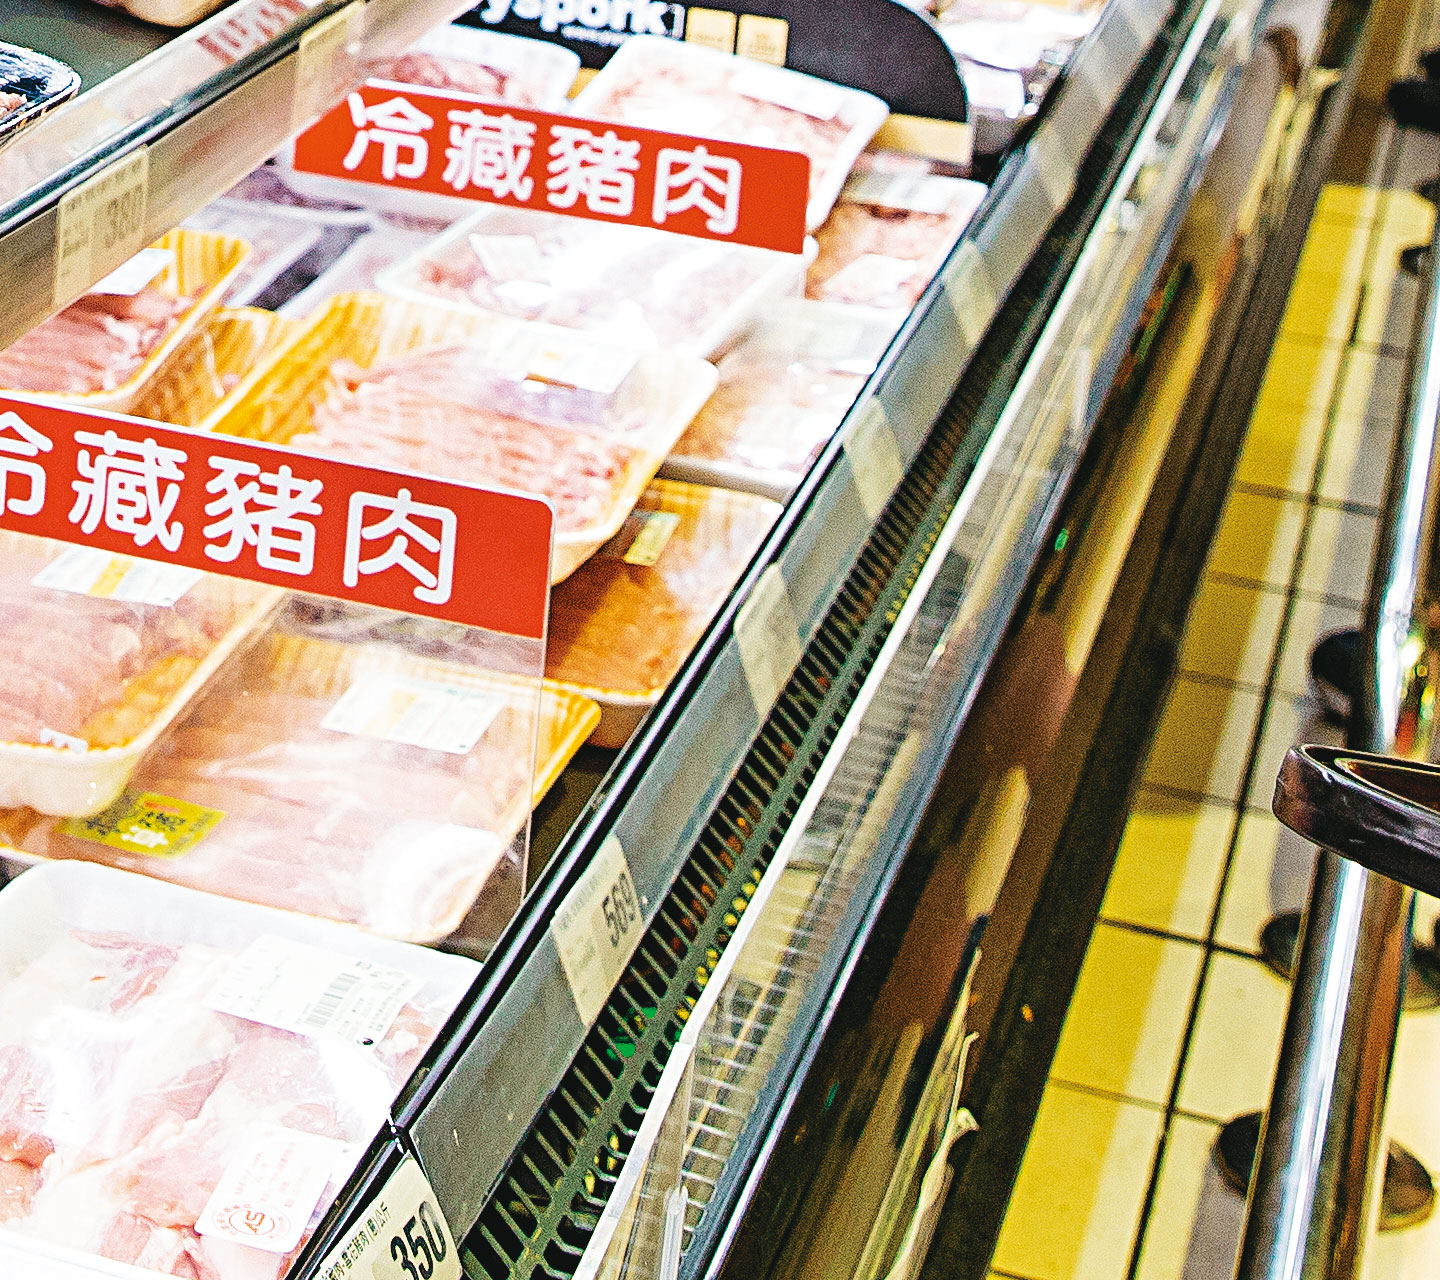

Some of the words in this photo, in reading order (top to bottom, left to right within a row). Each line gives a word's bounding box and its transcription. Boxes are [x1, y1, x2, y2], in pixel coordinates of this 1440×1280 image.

[342, 92, 743, 235] 冷藏豬肉
[391, 1201, 446, 1280] 350
